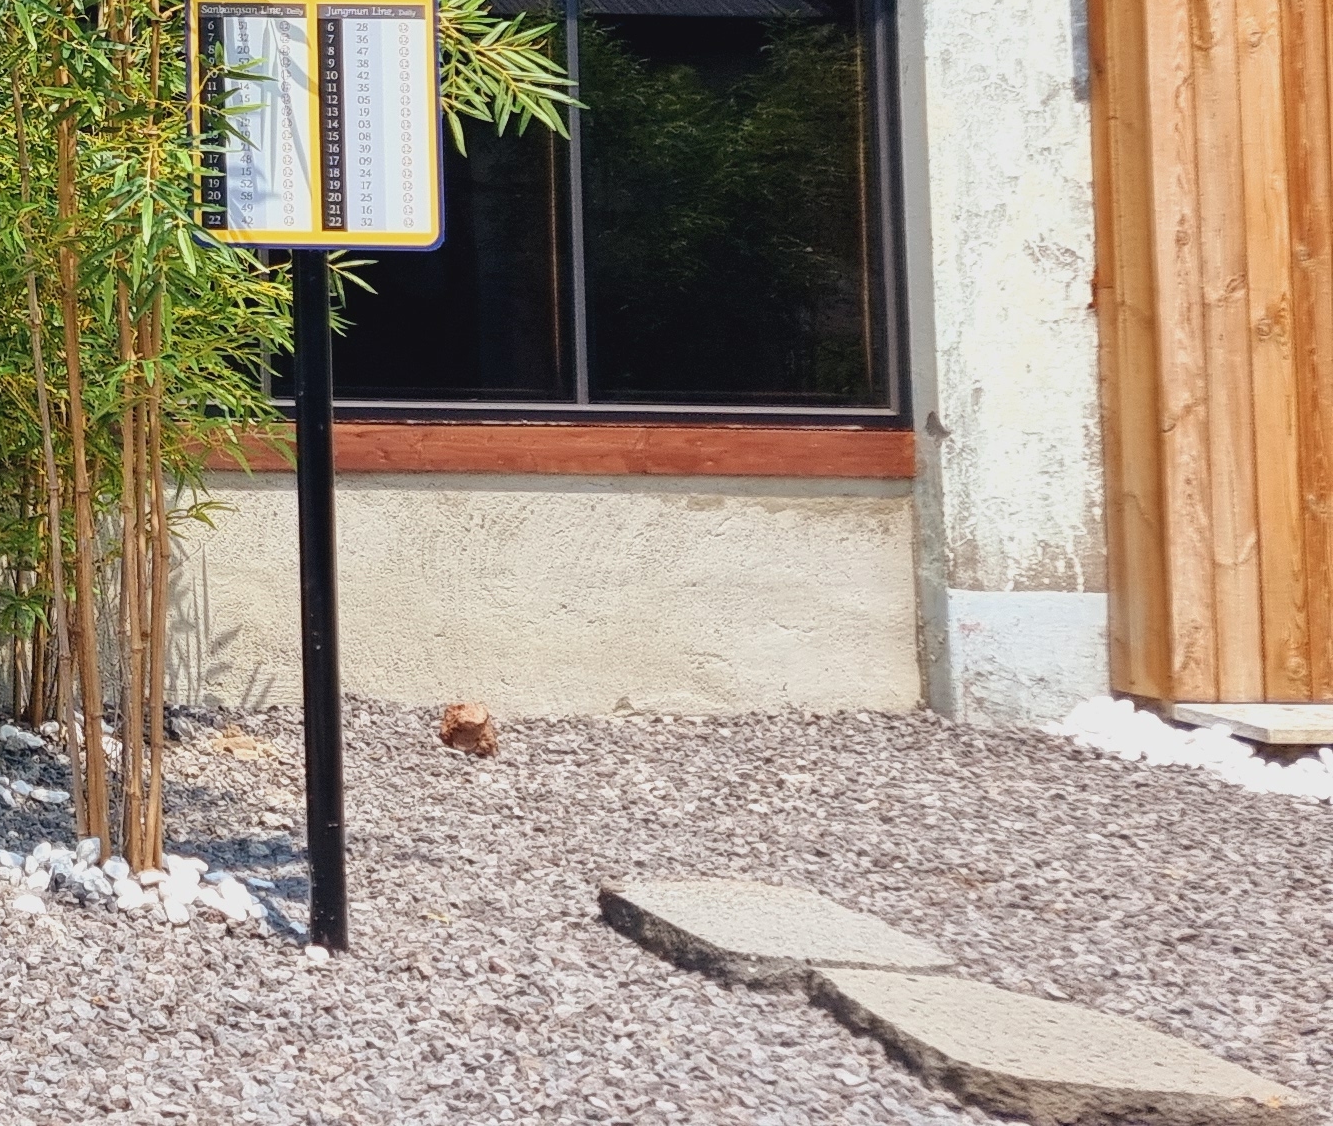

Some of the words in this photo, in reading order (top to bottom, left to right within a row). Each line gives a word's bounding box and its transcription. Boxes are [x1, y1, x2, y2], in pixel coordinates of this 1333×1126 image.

[327, 23, 335, 32] 6
[208, 33, 214, 42] 7
[327, 34, 334, 44] 7
[356, 35, 369, 44] 36
[237, 45, 250, 55] 20
[327, 46, 335, 55] 8
[328, 58, 335, 68] 9
[326, 70, 339, 80] 10
[356, 71, 370, 80] 42
[326, 83, 337, 92] 11
[357, 83, 370, 92] 35
[326, 95, 339, 104] 12
[357, 96, 371, 105] 05
[326, 107, 339, 117] 13
[359, 108, 370, 117] 19
[327, 119, 339, 129] 14
[358, 119, 371, 129] 03
[327, 131, 339, 141] 15
[358, 132, 372, 141] 08
[328, 144, 340, 153] 16
[209, 154, 219, 163] 17
[240, 155, 253, 164] 48
[329, 156, 340, 165] 17
[359, 156, 372, 166] 09
[241, 167, 252, 176] 15
[328, 168, 341, 178] 18
[359, 169, 372, 178] 24
[208, 179, 220, 188] 19
[240, 179, 253, 188] 52
[329, 180, 341, 190] 19
[361, 181, 372, 190] 17
[208, 191, 221, 200] 20
[328, 193, 342, 202] 20
[360, 193, 373, 202] 25
[241, 203, 253, 213] 49
[328, 205, 341, 214] 21
[361, 205, 373, 215] 16
[208, 215, 221, 225] 22
[328, 217, 342, 227] 22
[360, 218, 373, 227] 32
